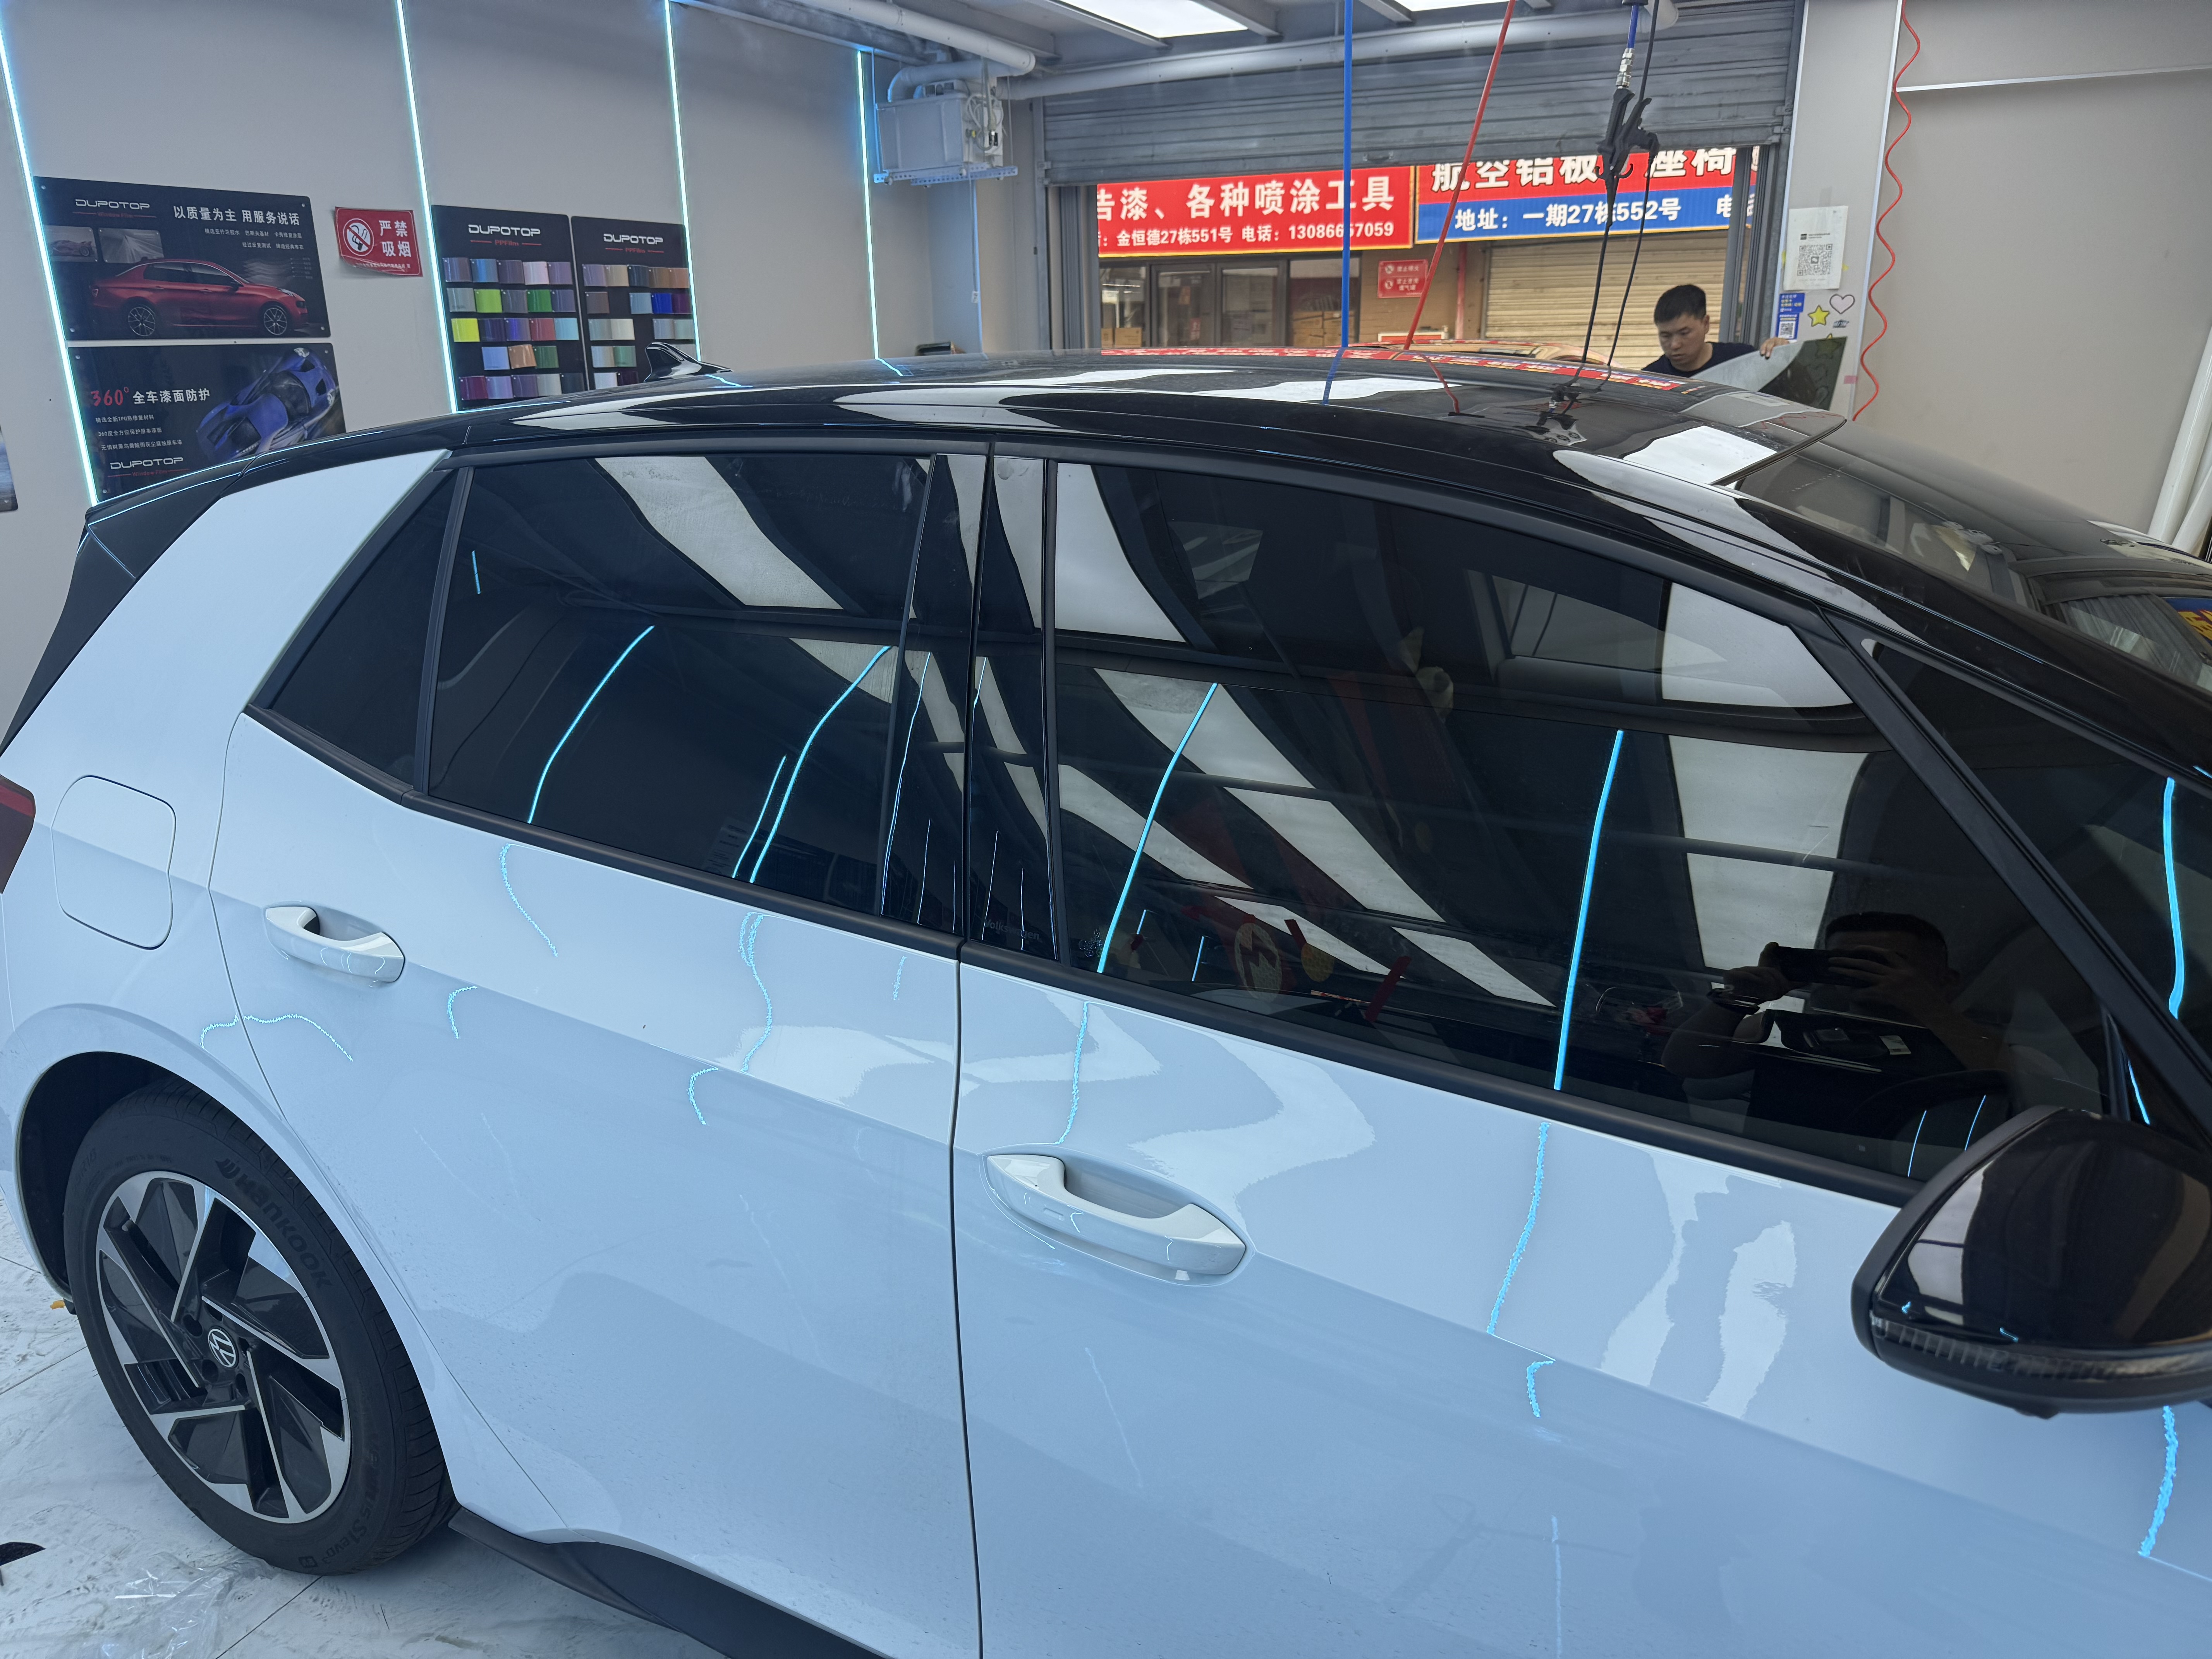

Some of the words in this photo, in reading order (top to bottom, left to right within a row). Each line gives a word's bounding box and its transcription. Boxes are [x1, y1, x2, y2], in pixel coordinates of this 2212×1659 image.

[75, 199, 150, 210] DUPOTOP
[173, 206, 237, 222] 以质量为主
[242, 210, 300, 225] 用服务说话
[378, 220, 408, 237] 严禁
[468, 224, 541, 237] DUPOTOP
[603, 234, 663, 245] DUPOTOP
[381, 240, 412, 257] 吸烟
[132, 388, 210, 404] 全车漆面防护
[110, 457, 184, 470] DUPOTOP
